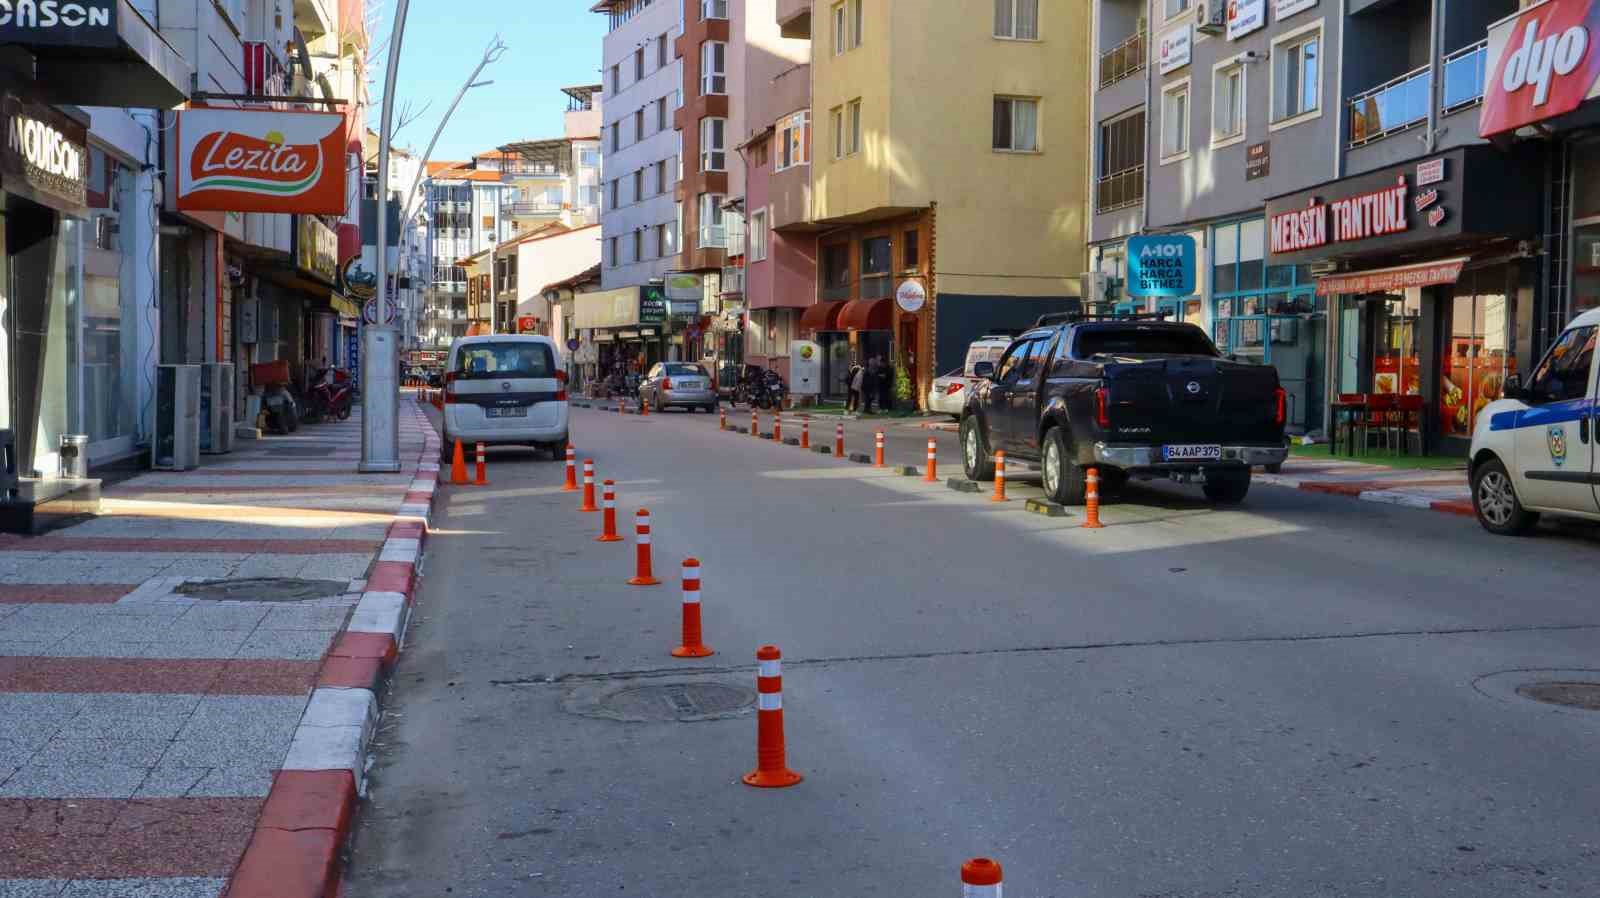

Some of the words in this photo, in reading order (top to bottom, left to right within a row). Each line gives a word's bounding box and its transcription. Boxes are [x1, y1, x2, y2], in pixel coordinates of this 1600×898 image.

[1503, 19, 1586, 106] dyo
[8, 114, 79, 180] MODASON
[202, 131, 307, 173] Lezita
[1271, 198, 1326, 253] MERSİN
[1331, 175, 1408, 241] TANTUNİ
[1140, 258, 1183, 268] HARCA
[1140, 269, 1183, 279] HARCA
